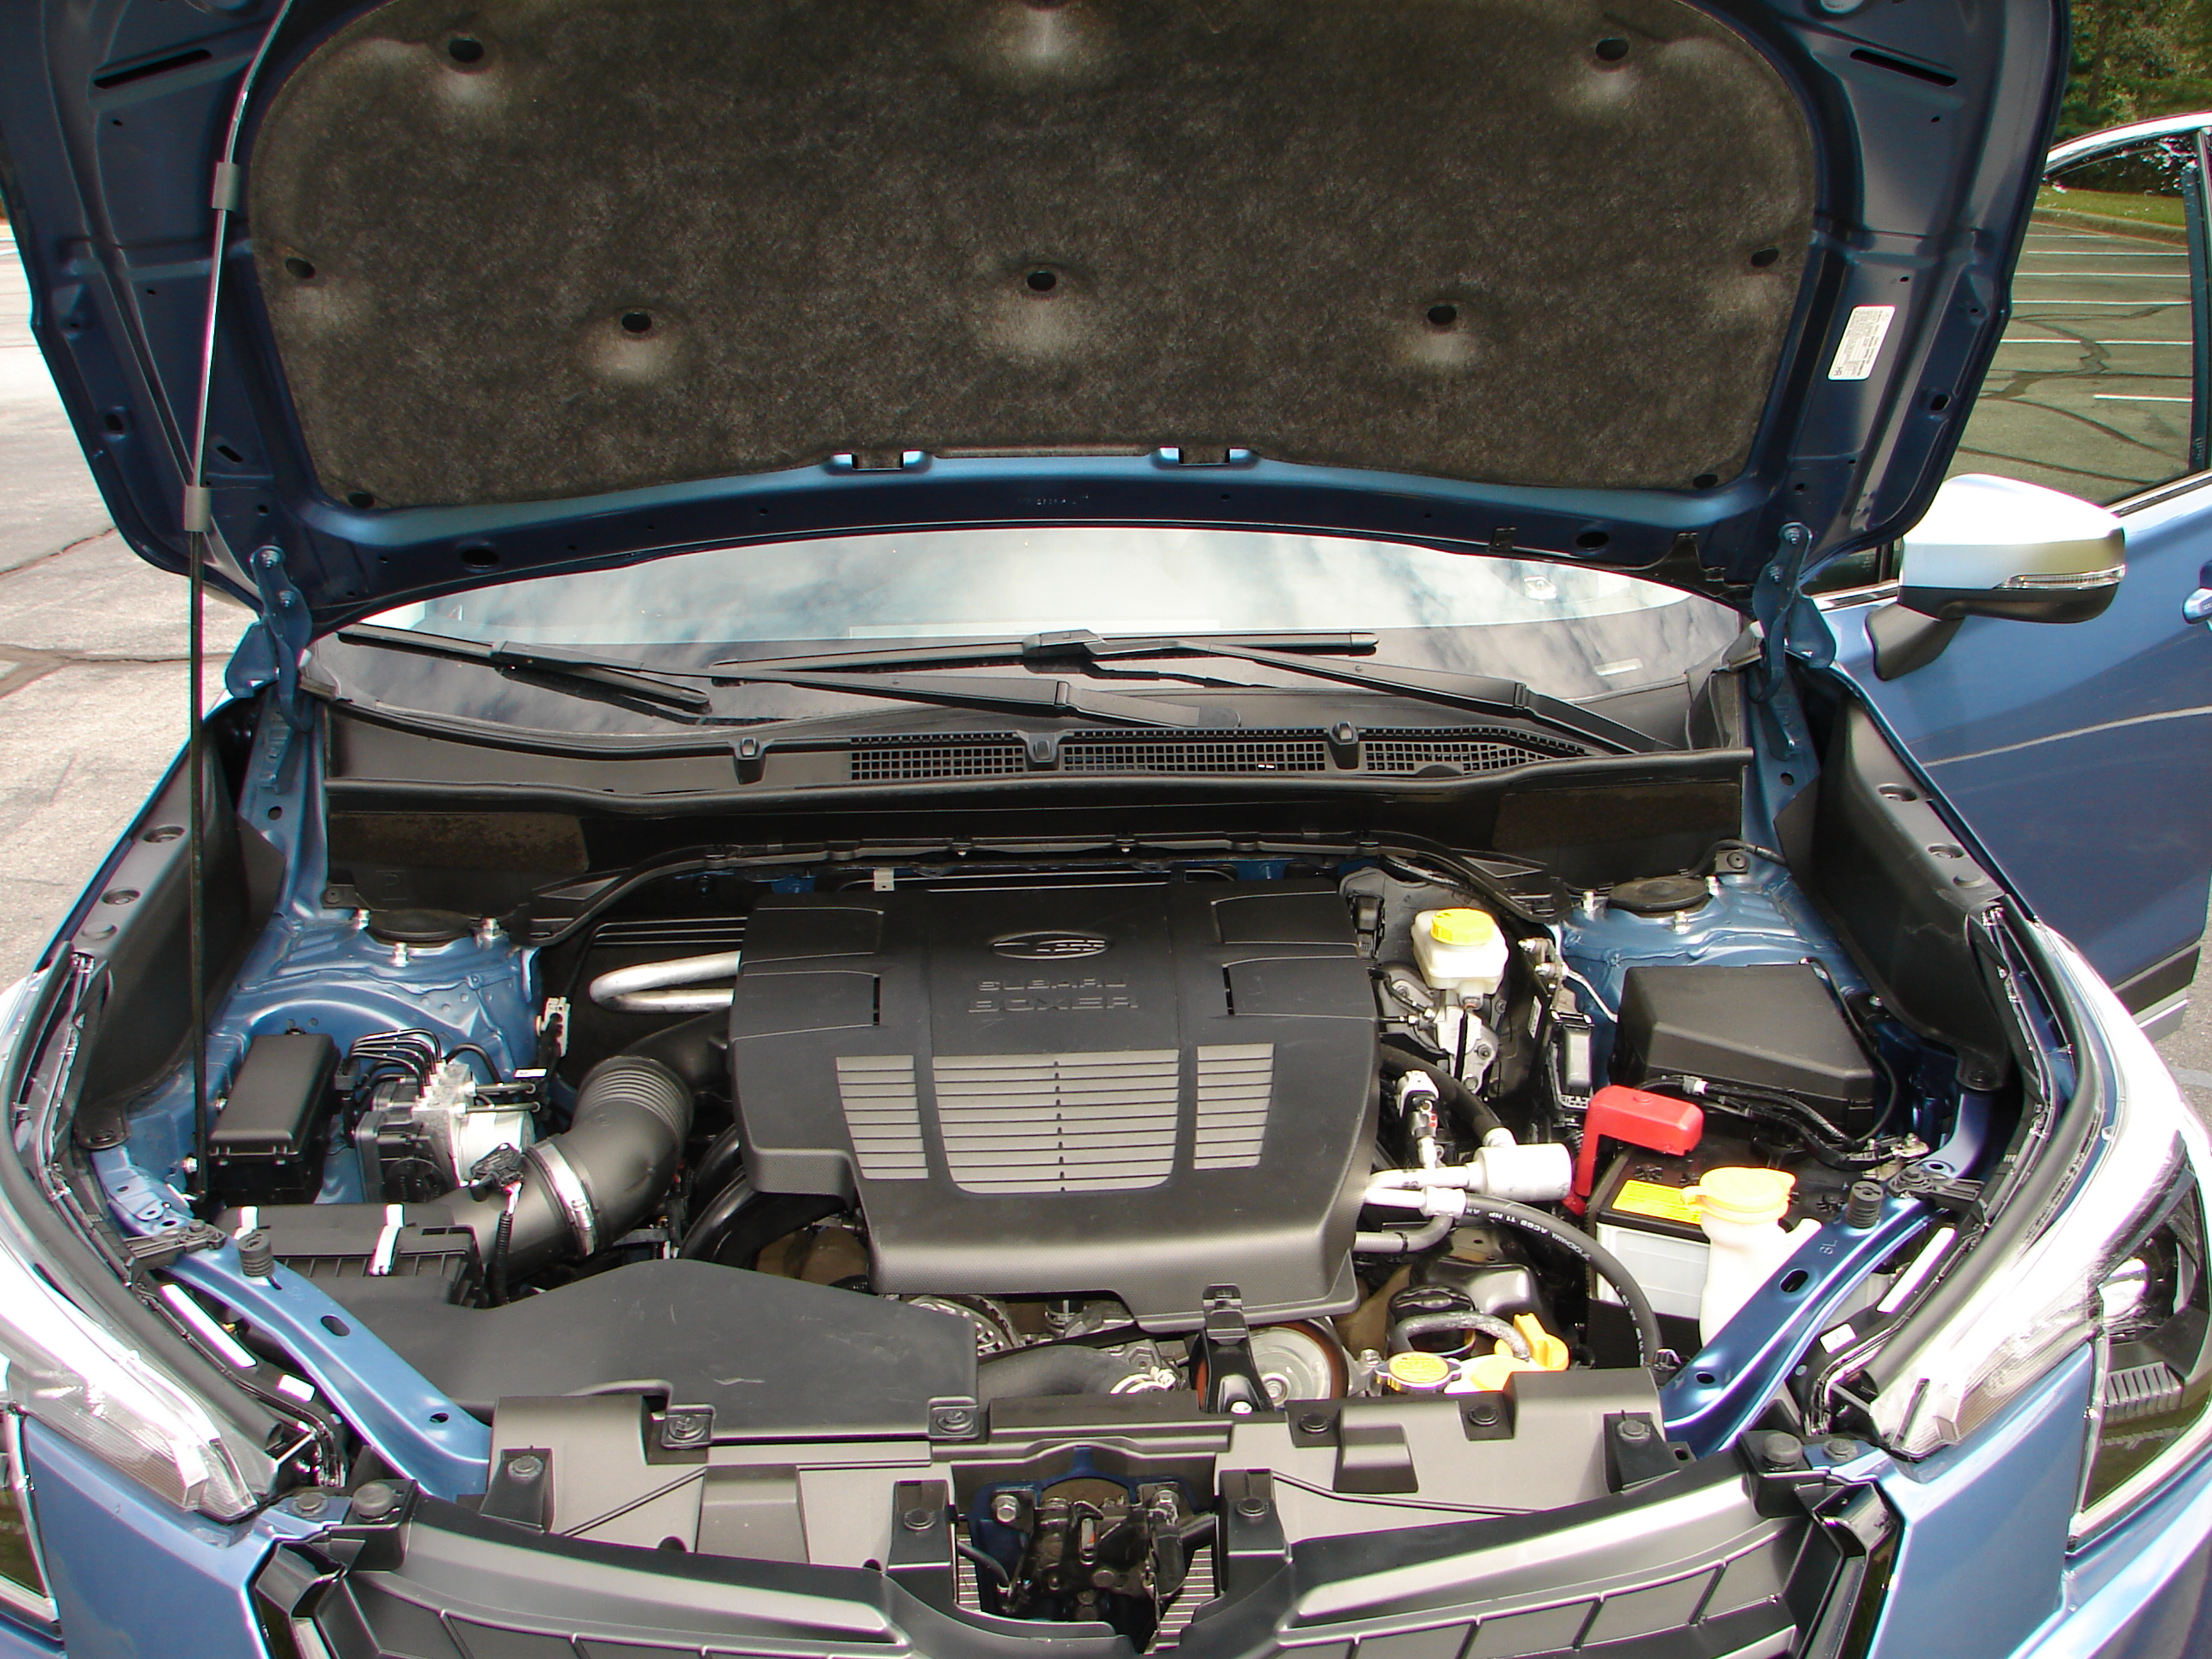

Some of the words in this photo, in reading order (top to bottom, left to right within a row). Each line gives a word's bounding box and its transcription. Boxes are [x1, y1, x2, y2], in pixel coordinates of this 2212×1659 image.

[977, 977, 1127, 992] SUBARU
[968, 995, 1140, 1014] BOXER
[1487, 1212, 1504, 1220] HP
